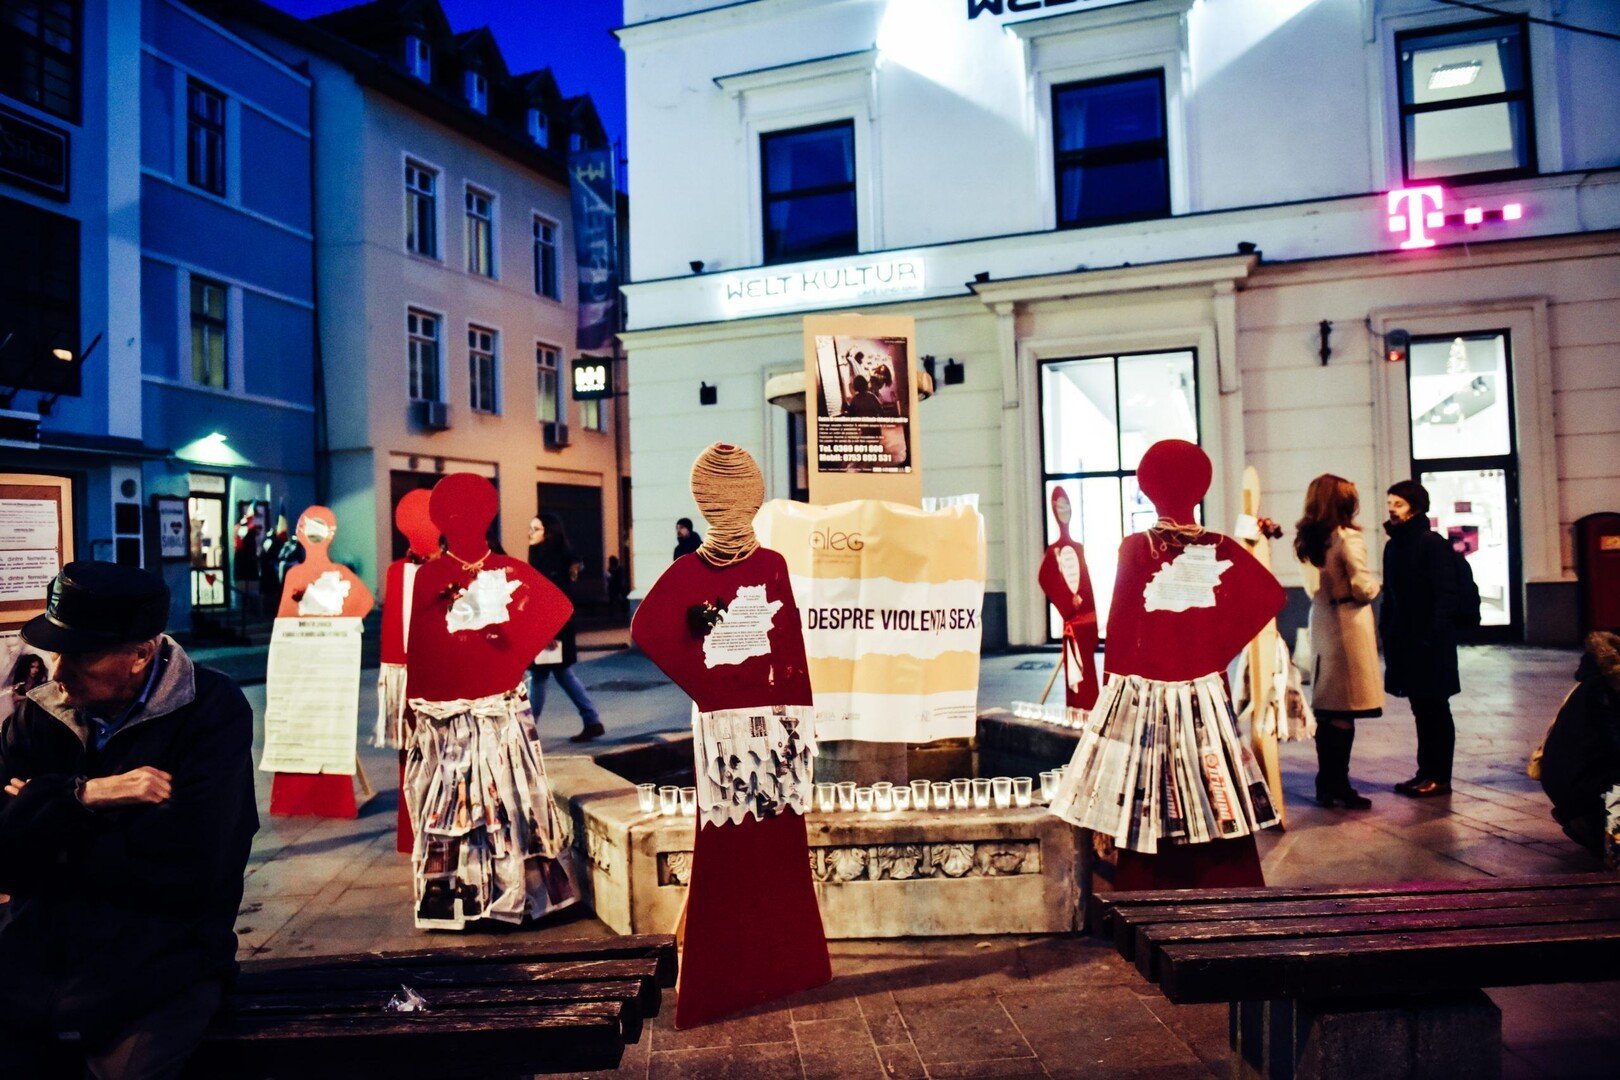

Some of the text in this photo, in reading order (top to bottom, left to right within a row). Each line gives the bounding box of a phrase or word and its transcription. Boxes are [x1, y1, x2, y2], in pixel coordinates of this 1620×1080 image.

[727, 262, 916, 300] WELT KULTUR
[808, 607, 875, 630] DESPRE
[949, 608, 976, 630] SEX
